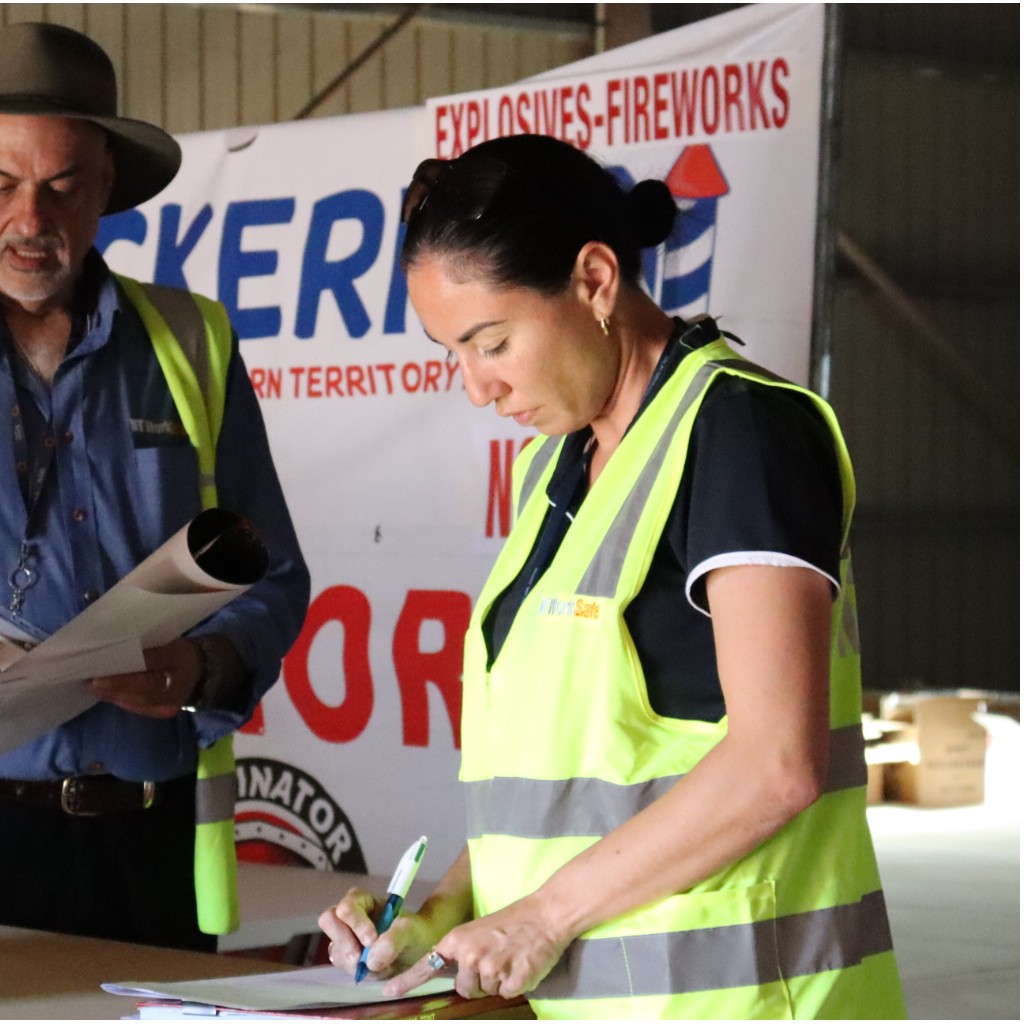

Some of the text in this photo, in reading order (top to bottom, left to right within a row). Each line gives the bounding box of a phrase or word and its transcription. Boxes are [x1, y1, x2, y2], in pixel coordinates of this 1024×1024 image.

[435, 57, 790, 160] EXPLOSIVES-FIREWORKS
[289, 359, 461, 399] TERRITORY
[486, 437, 536, 539] N
[240, 584, 472, 750] OR
[237, 761, 354, 870] INATOR
